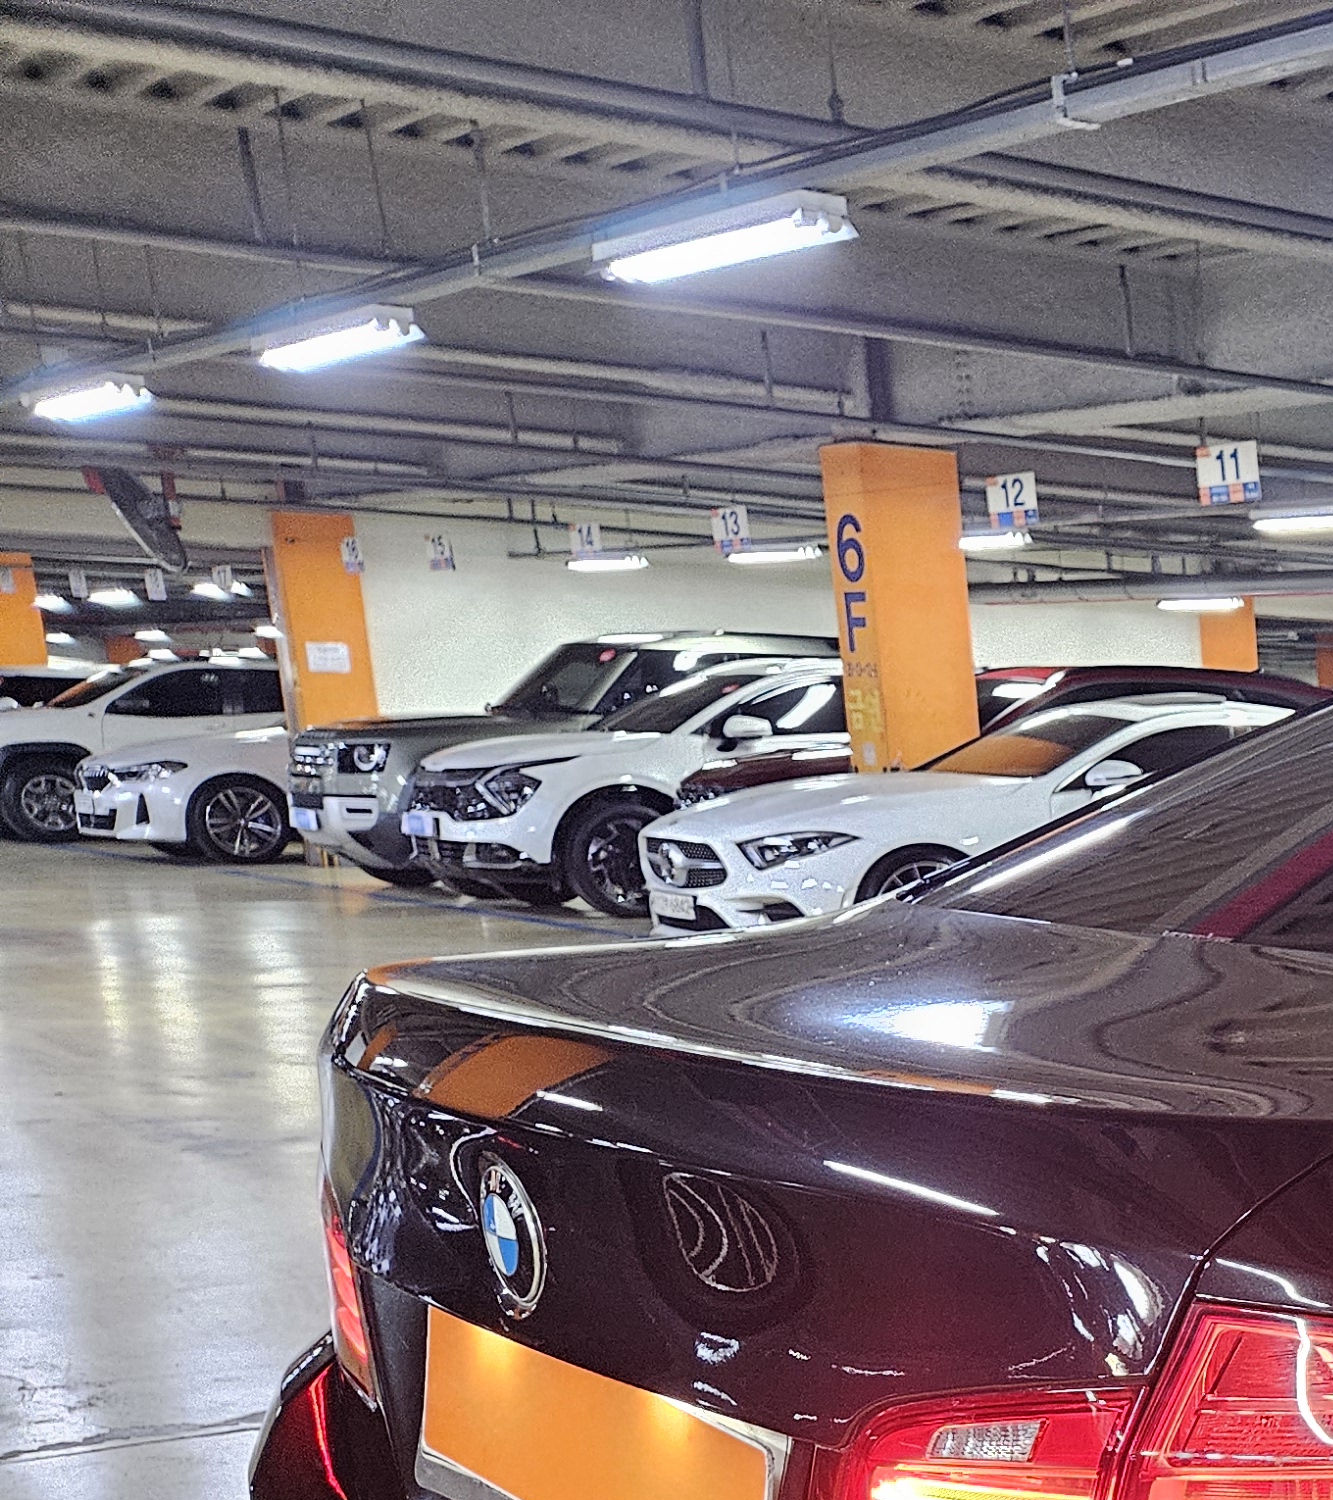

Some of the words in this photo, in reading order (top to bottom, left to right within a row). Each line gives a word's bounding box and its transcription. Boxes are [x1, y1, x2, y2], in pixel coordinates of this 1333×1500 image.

[1216, 448, 1240, 481] 11
[1001, 477, 1026, 508] 12
[577, 525, 594, 547] 14
[720, 510, 741, 536] 13
